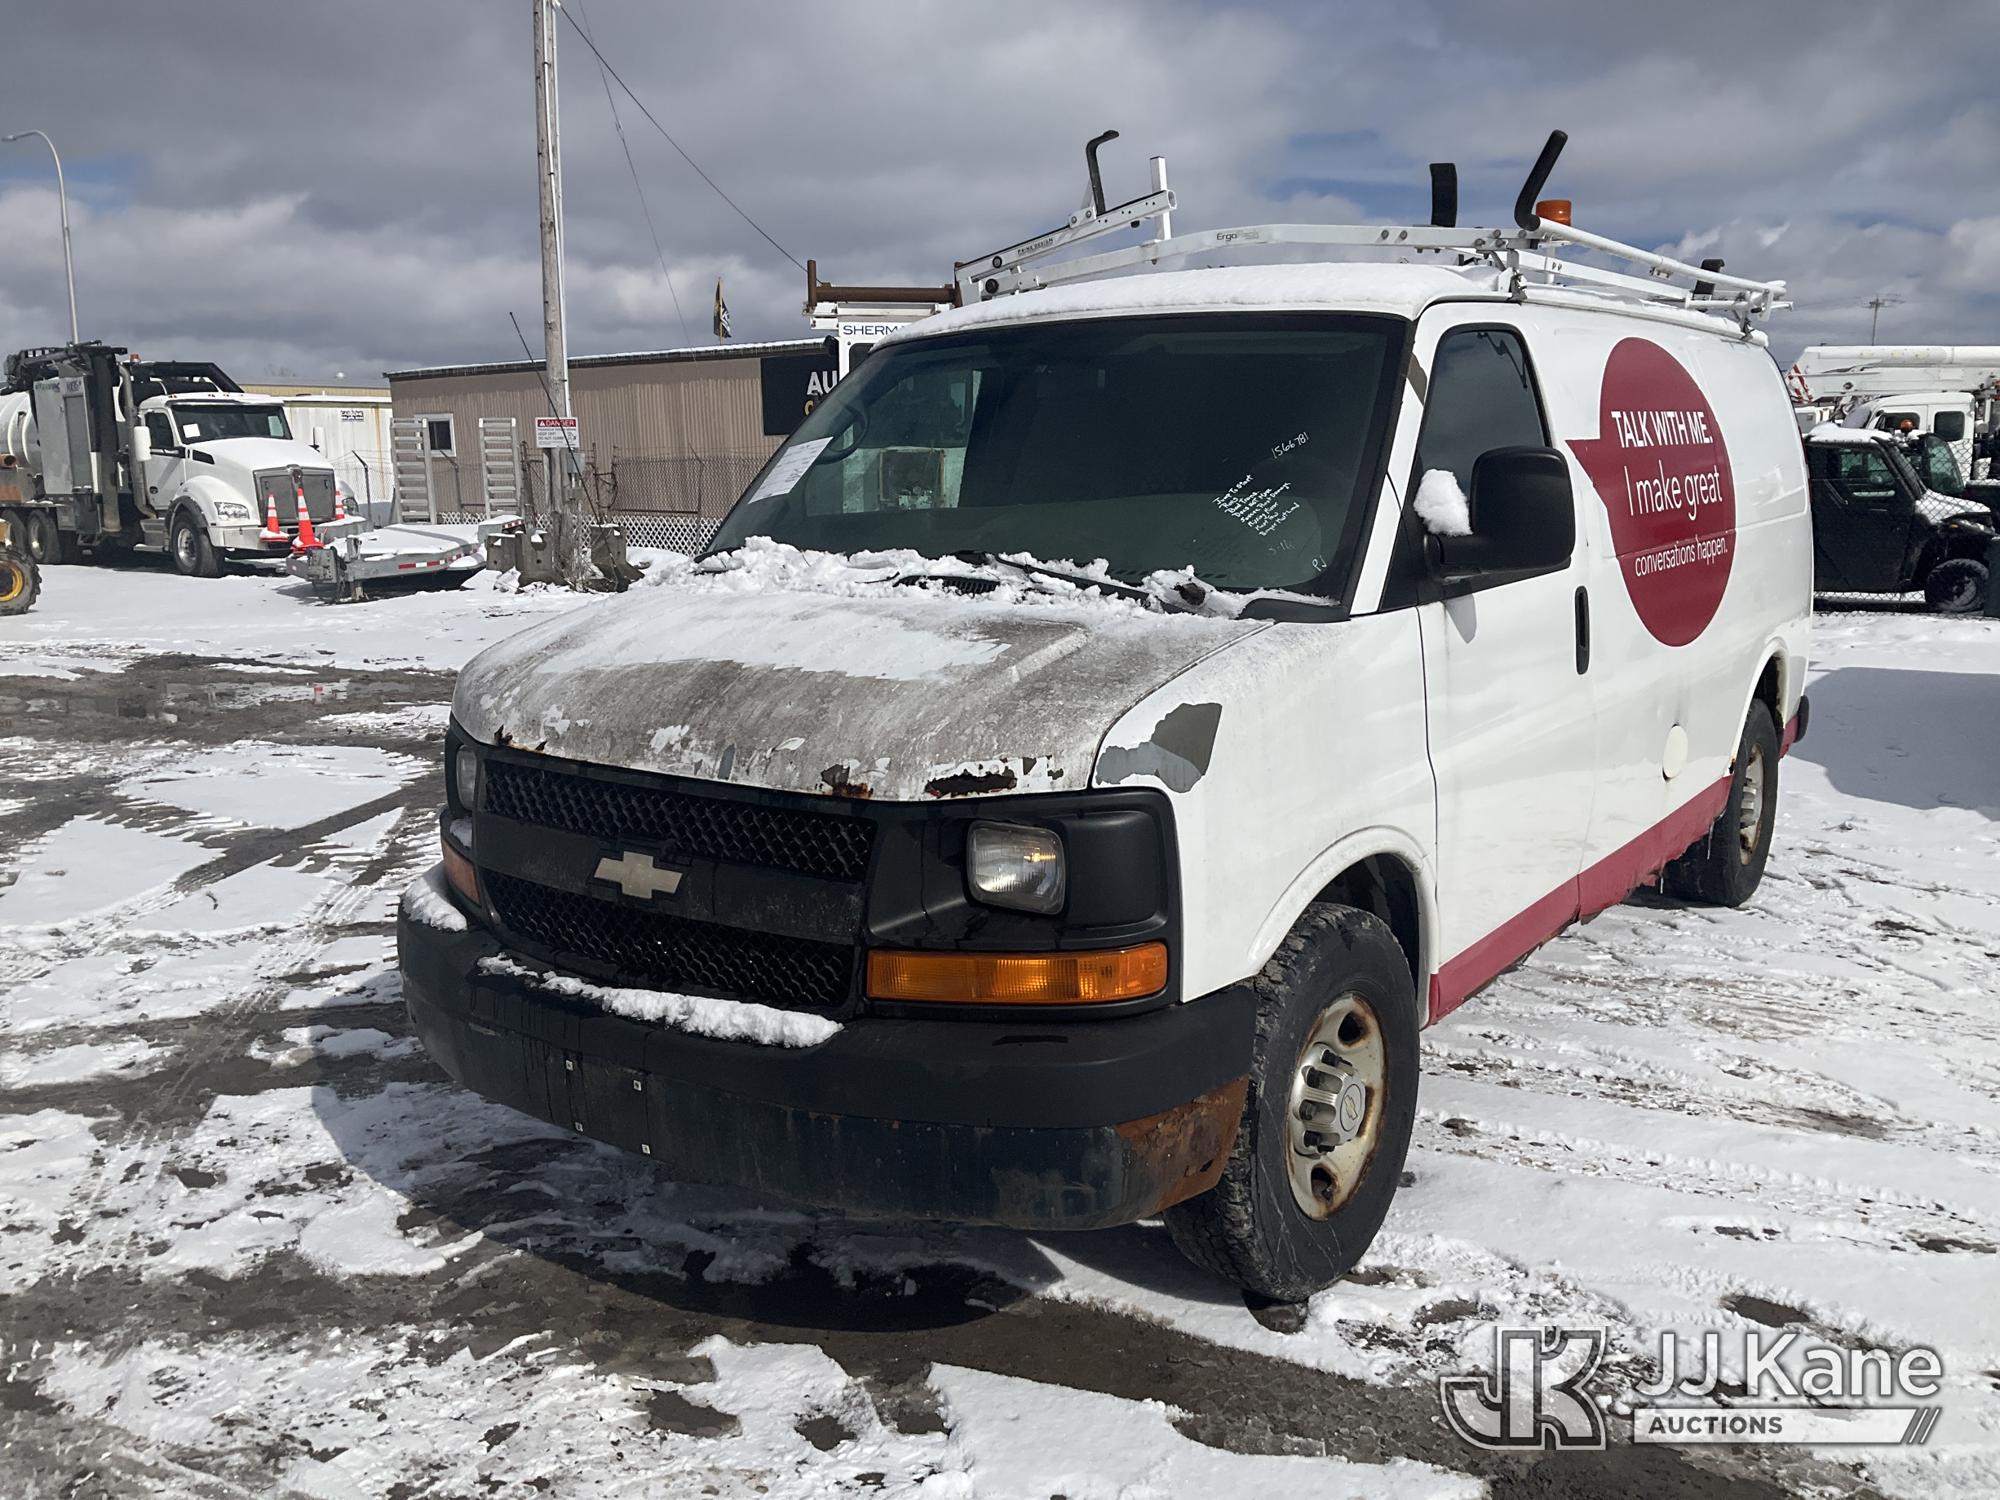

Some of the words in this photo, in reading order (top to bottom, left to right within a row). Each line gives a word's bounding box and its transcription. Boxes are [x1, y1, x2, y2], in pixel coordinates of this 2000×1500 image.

[842, 324, 905, 336] SHERM
[1610, 410, 1655, 448] TALK
[1650, 410, 1690, 446] WITH
[1686, 411, 1713, 445] ME.
[1623, 465, 1634, 516] I
[1635, 459, 1681, 515] make
[1684, 464, 1723, 521] great
[1635, 540, 1696, 577] conversations
[1695, 533, 1728, 566] happen.
